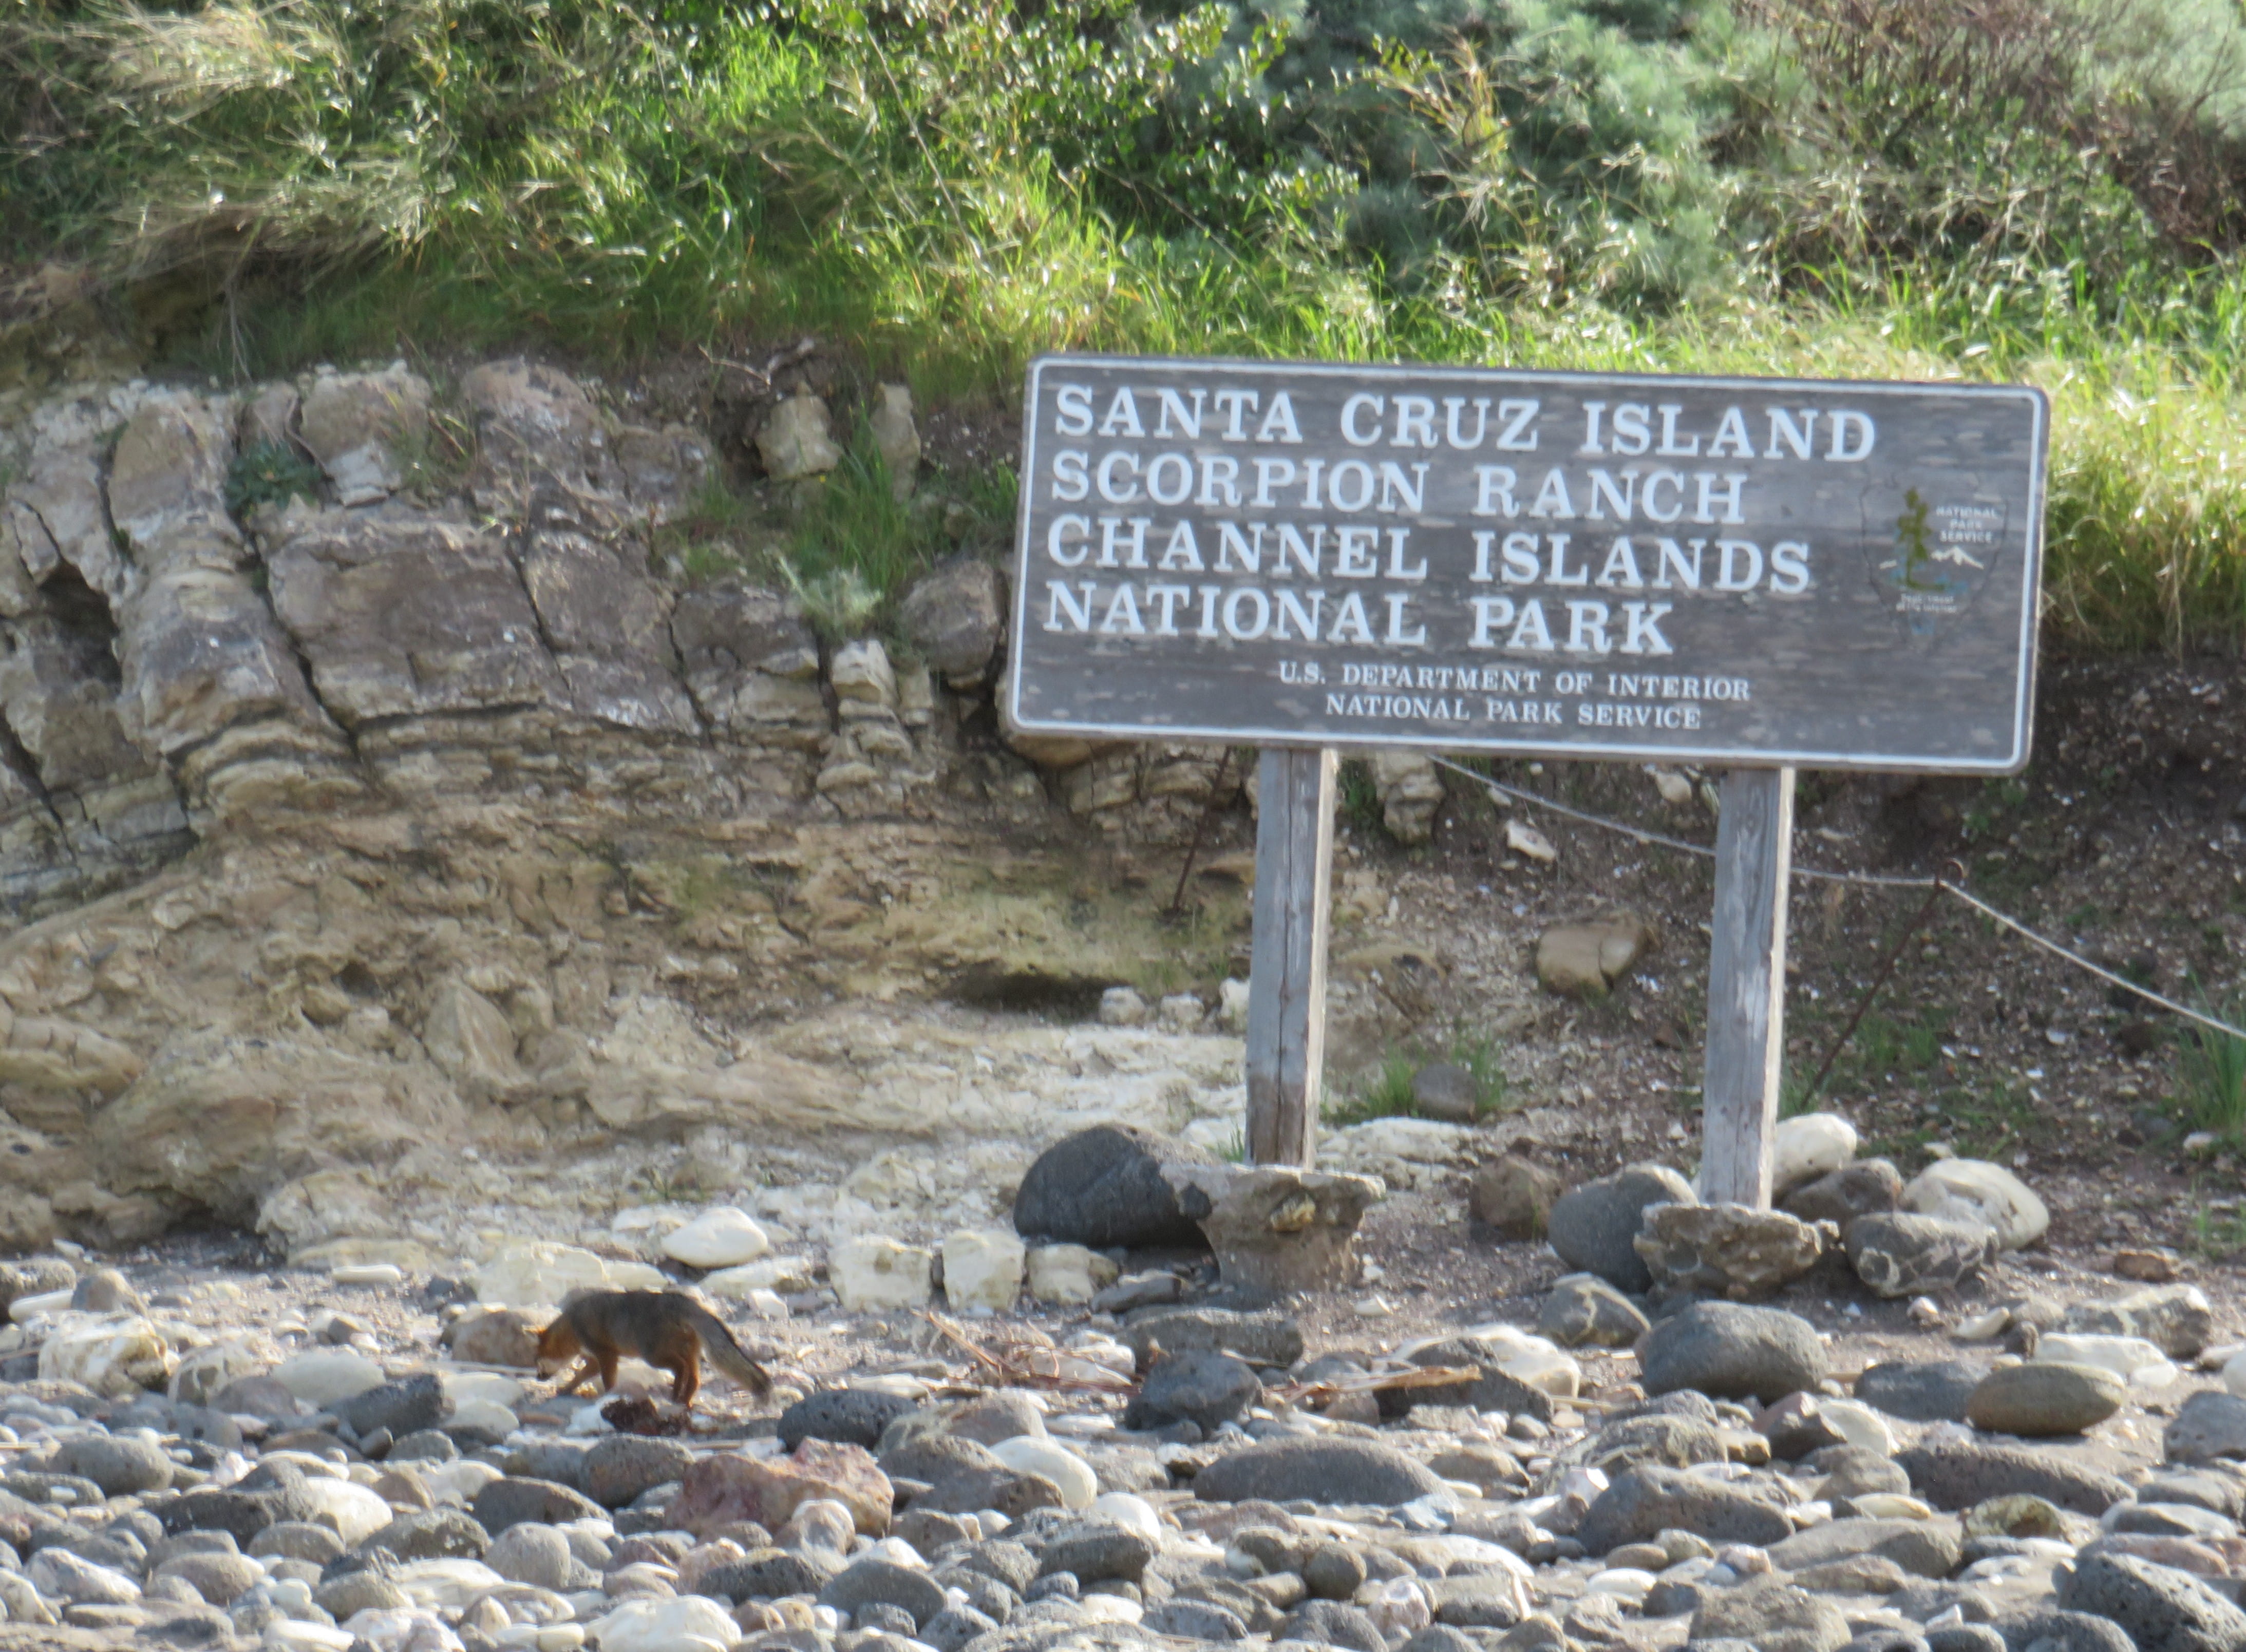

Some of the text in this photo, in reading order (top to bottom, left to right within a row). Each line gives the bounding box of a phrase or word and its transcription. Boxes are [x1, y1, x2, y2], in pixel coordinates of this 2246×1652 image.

[1055, 386, 1876, 462] SANTA CRUZ ISLAND
[1050, 449, 1746, 524] SCORPION RANCH
[1936, 506, 1998, 519] NATIONAL
[1950, 519, 1983, 530] PARK
[1046, 514, 1811, 594] CHANNEL ISLANDS
[1940, 530, 1992, 543] SERVICE
[1043, 579, 1674, 656] NATIONAL PARK
[1278, 661, 1751, 701] U.S. DEPARTMENT OF INTERIOR
[1326, 694, 1701, 729] NATIONAL PARK SERVICE
